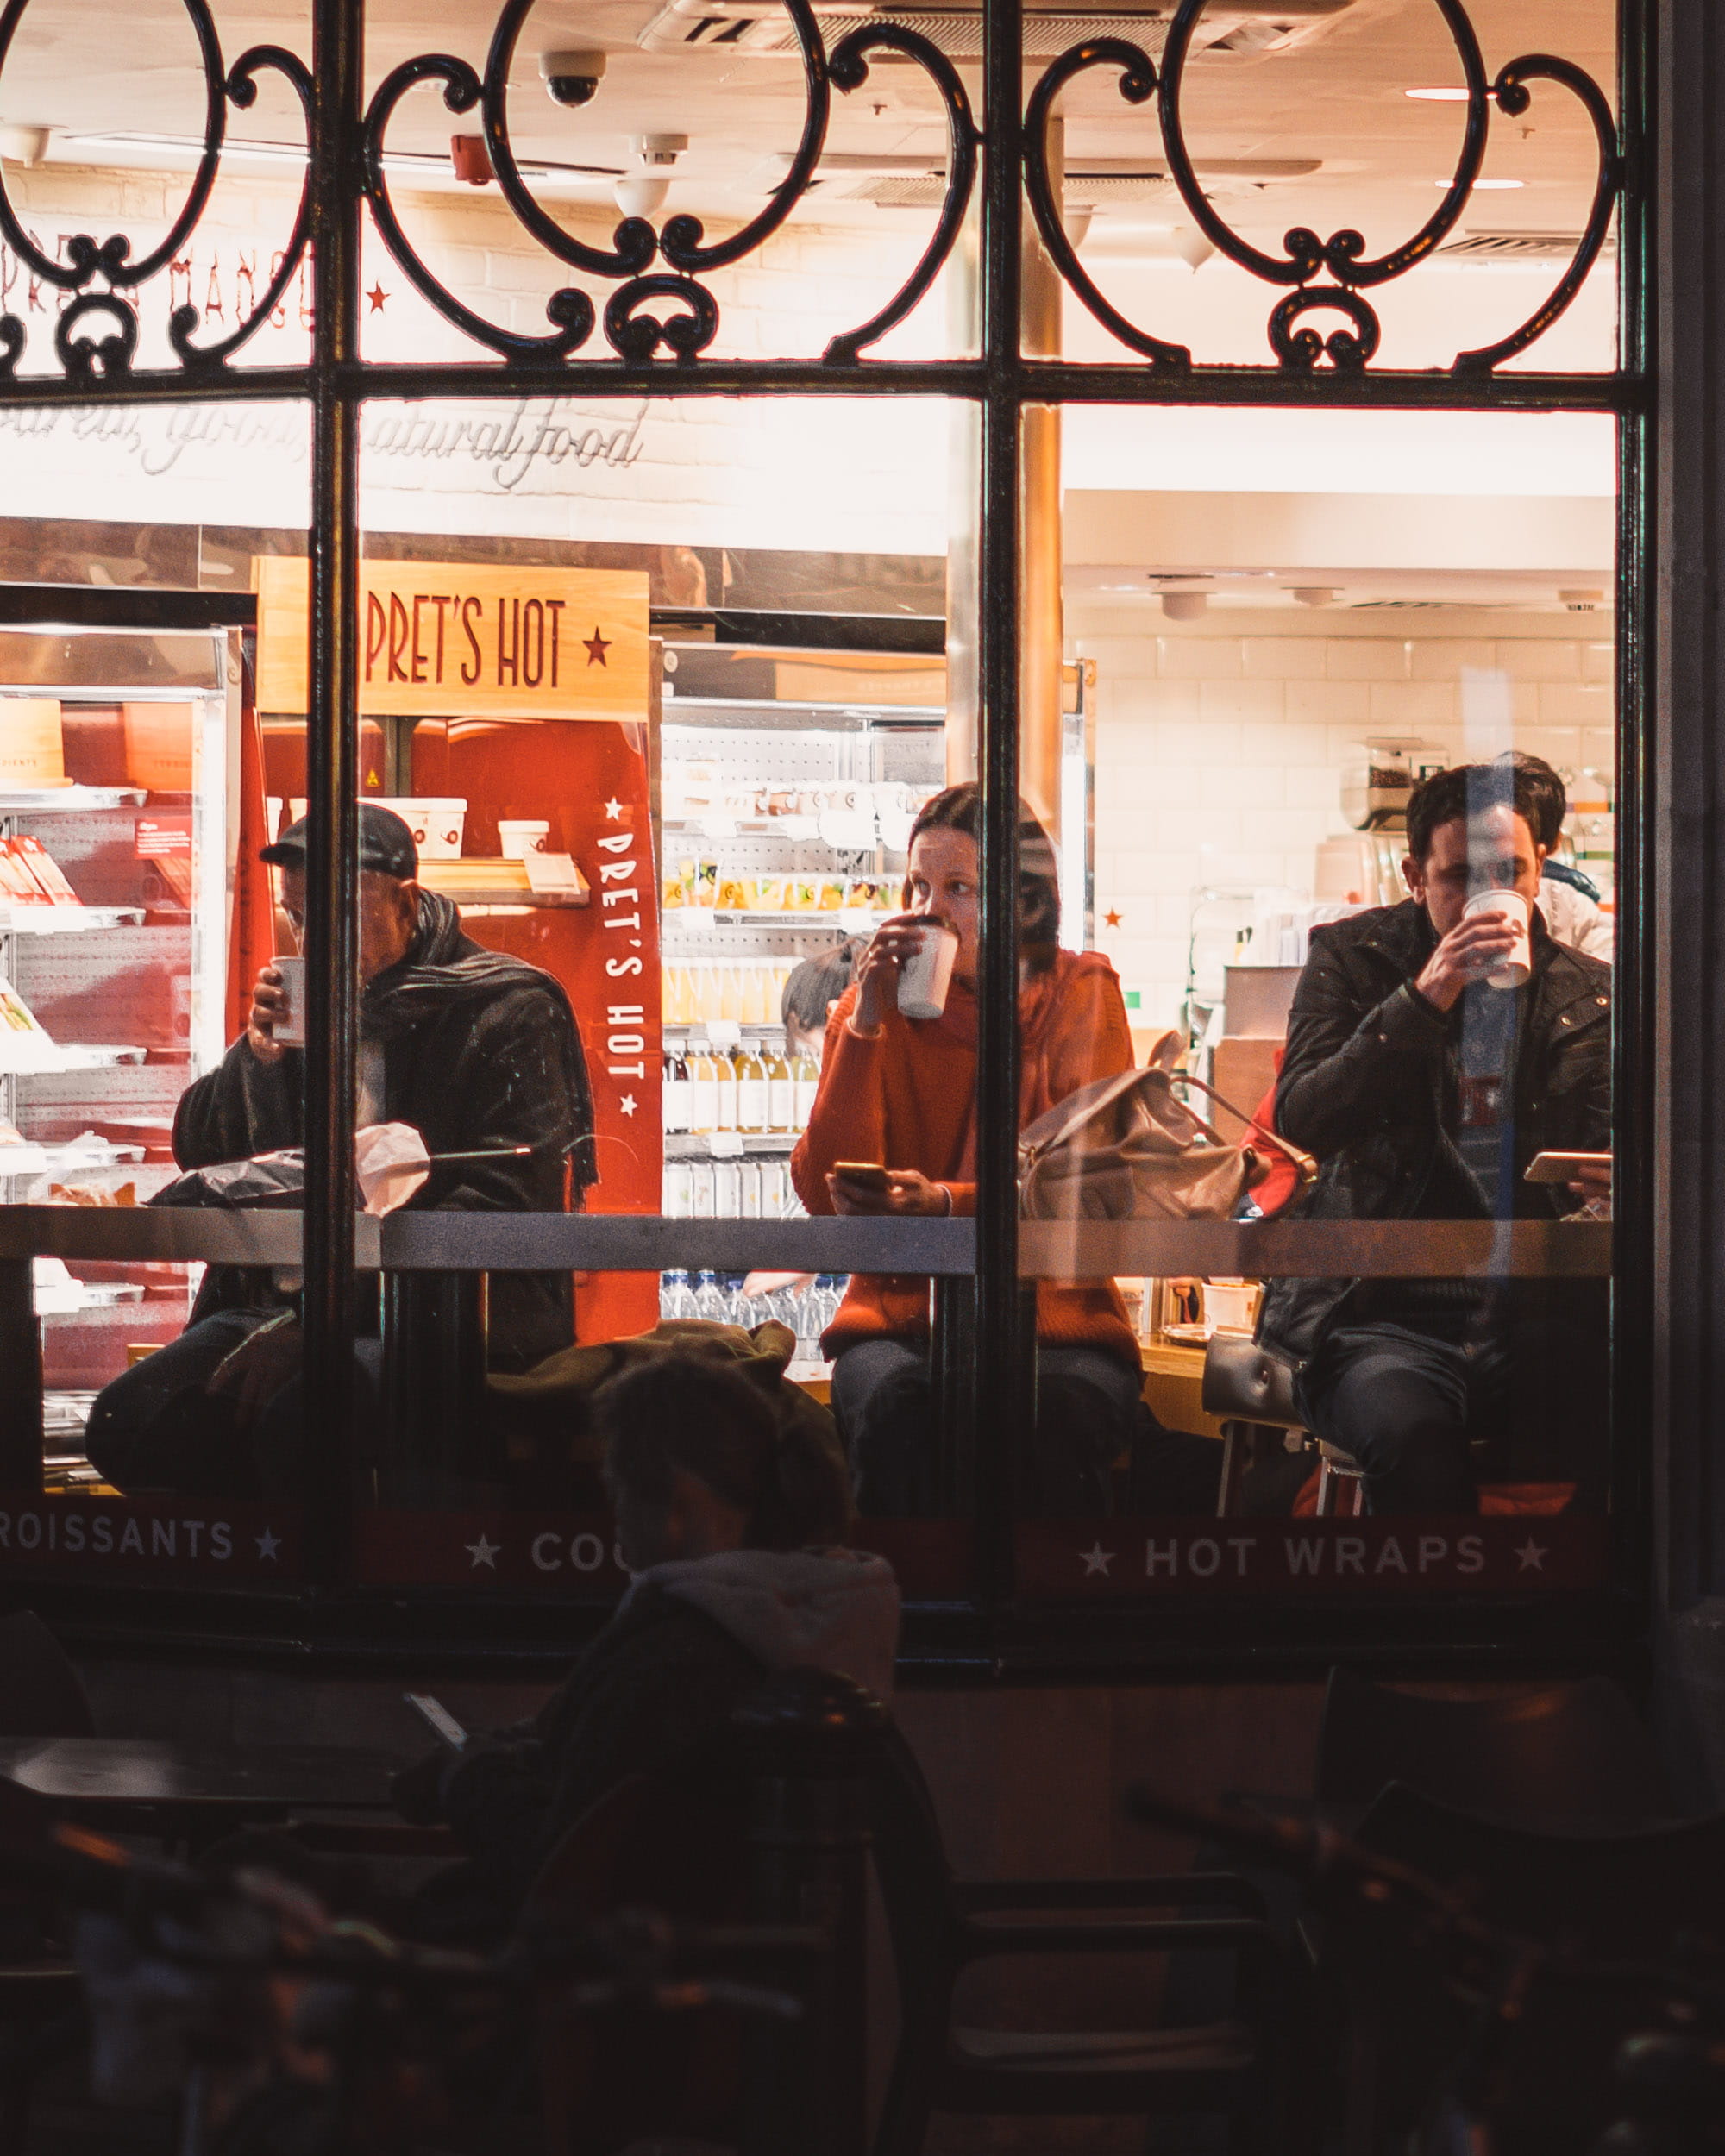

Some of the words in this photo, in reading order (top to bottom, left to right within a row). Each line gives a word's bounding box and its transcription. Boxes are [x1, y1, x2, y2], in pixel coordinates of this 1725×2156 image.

[492, 400, 644, 489] food
[366, 591, 482, 686] PRET'S
[498, 598, 566, 688] HOT
[597, 833, 643, 977] PRET'S
[606, 1005, 645, 1080] HOT
[1145, 1537, 1257, 1577] HOT
[1283, 1535, 1485, 1576] WRAPS
